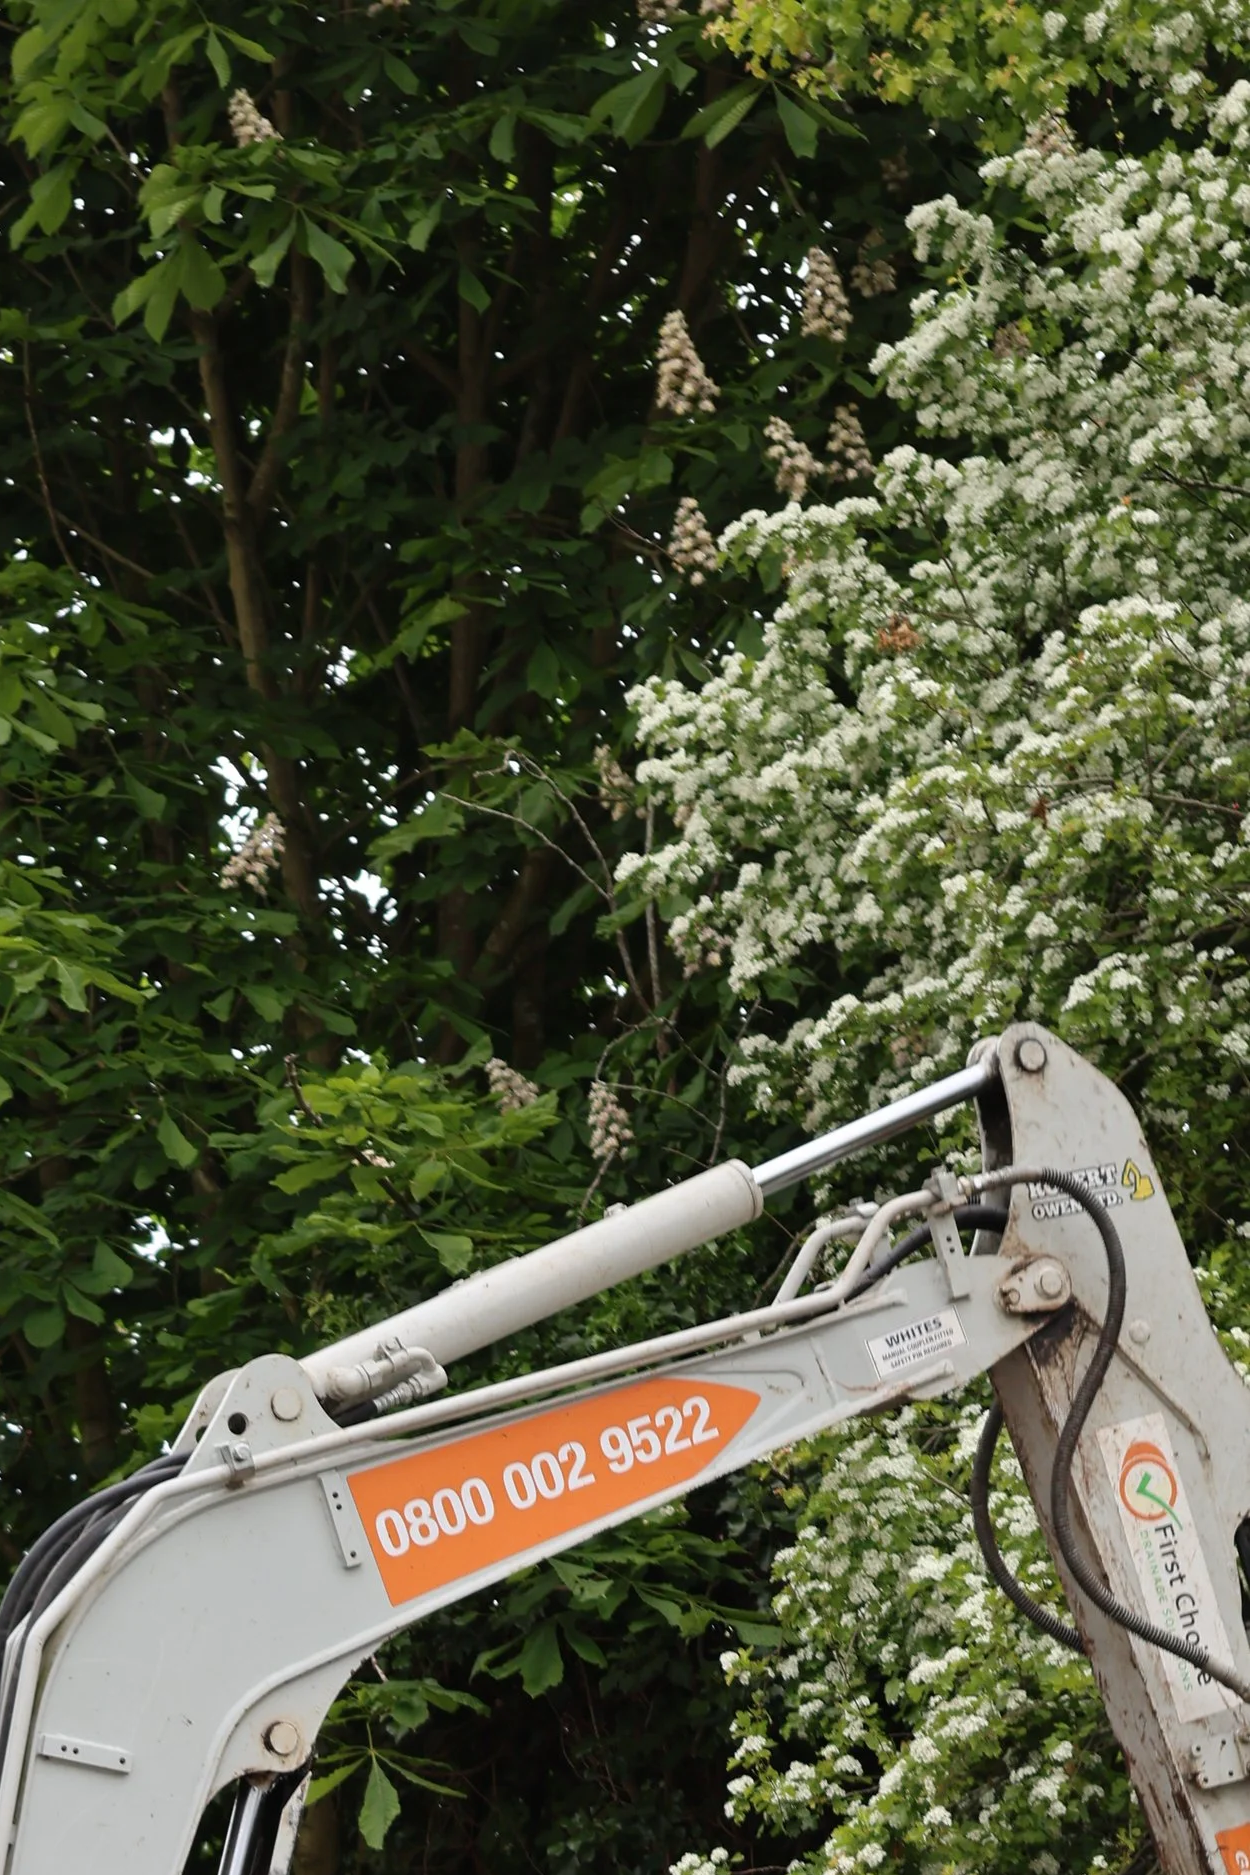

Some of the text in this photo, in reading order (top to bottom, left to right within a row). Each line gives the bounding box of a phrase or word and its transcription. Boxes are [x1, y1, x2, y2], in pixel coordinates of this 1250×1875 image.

[882, 1348, 906, 1361] MANUAL
[885, 1317, 942, 1348] WHITES
[890, 1339, 953, 1369] SAFETY PIN REQUIRED
[375, 1396, 719, 1558] 0800 002 9522
[1140, 1530, 1168, 1604] DRAINAGE
[1154, 1523, 1212, 1687] First Choe
